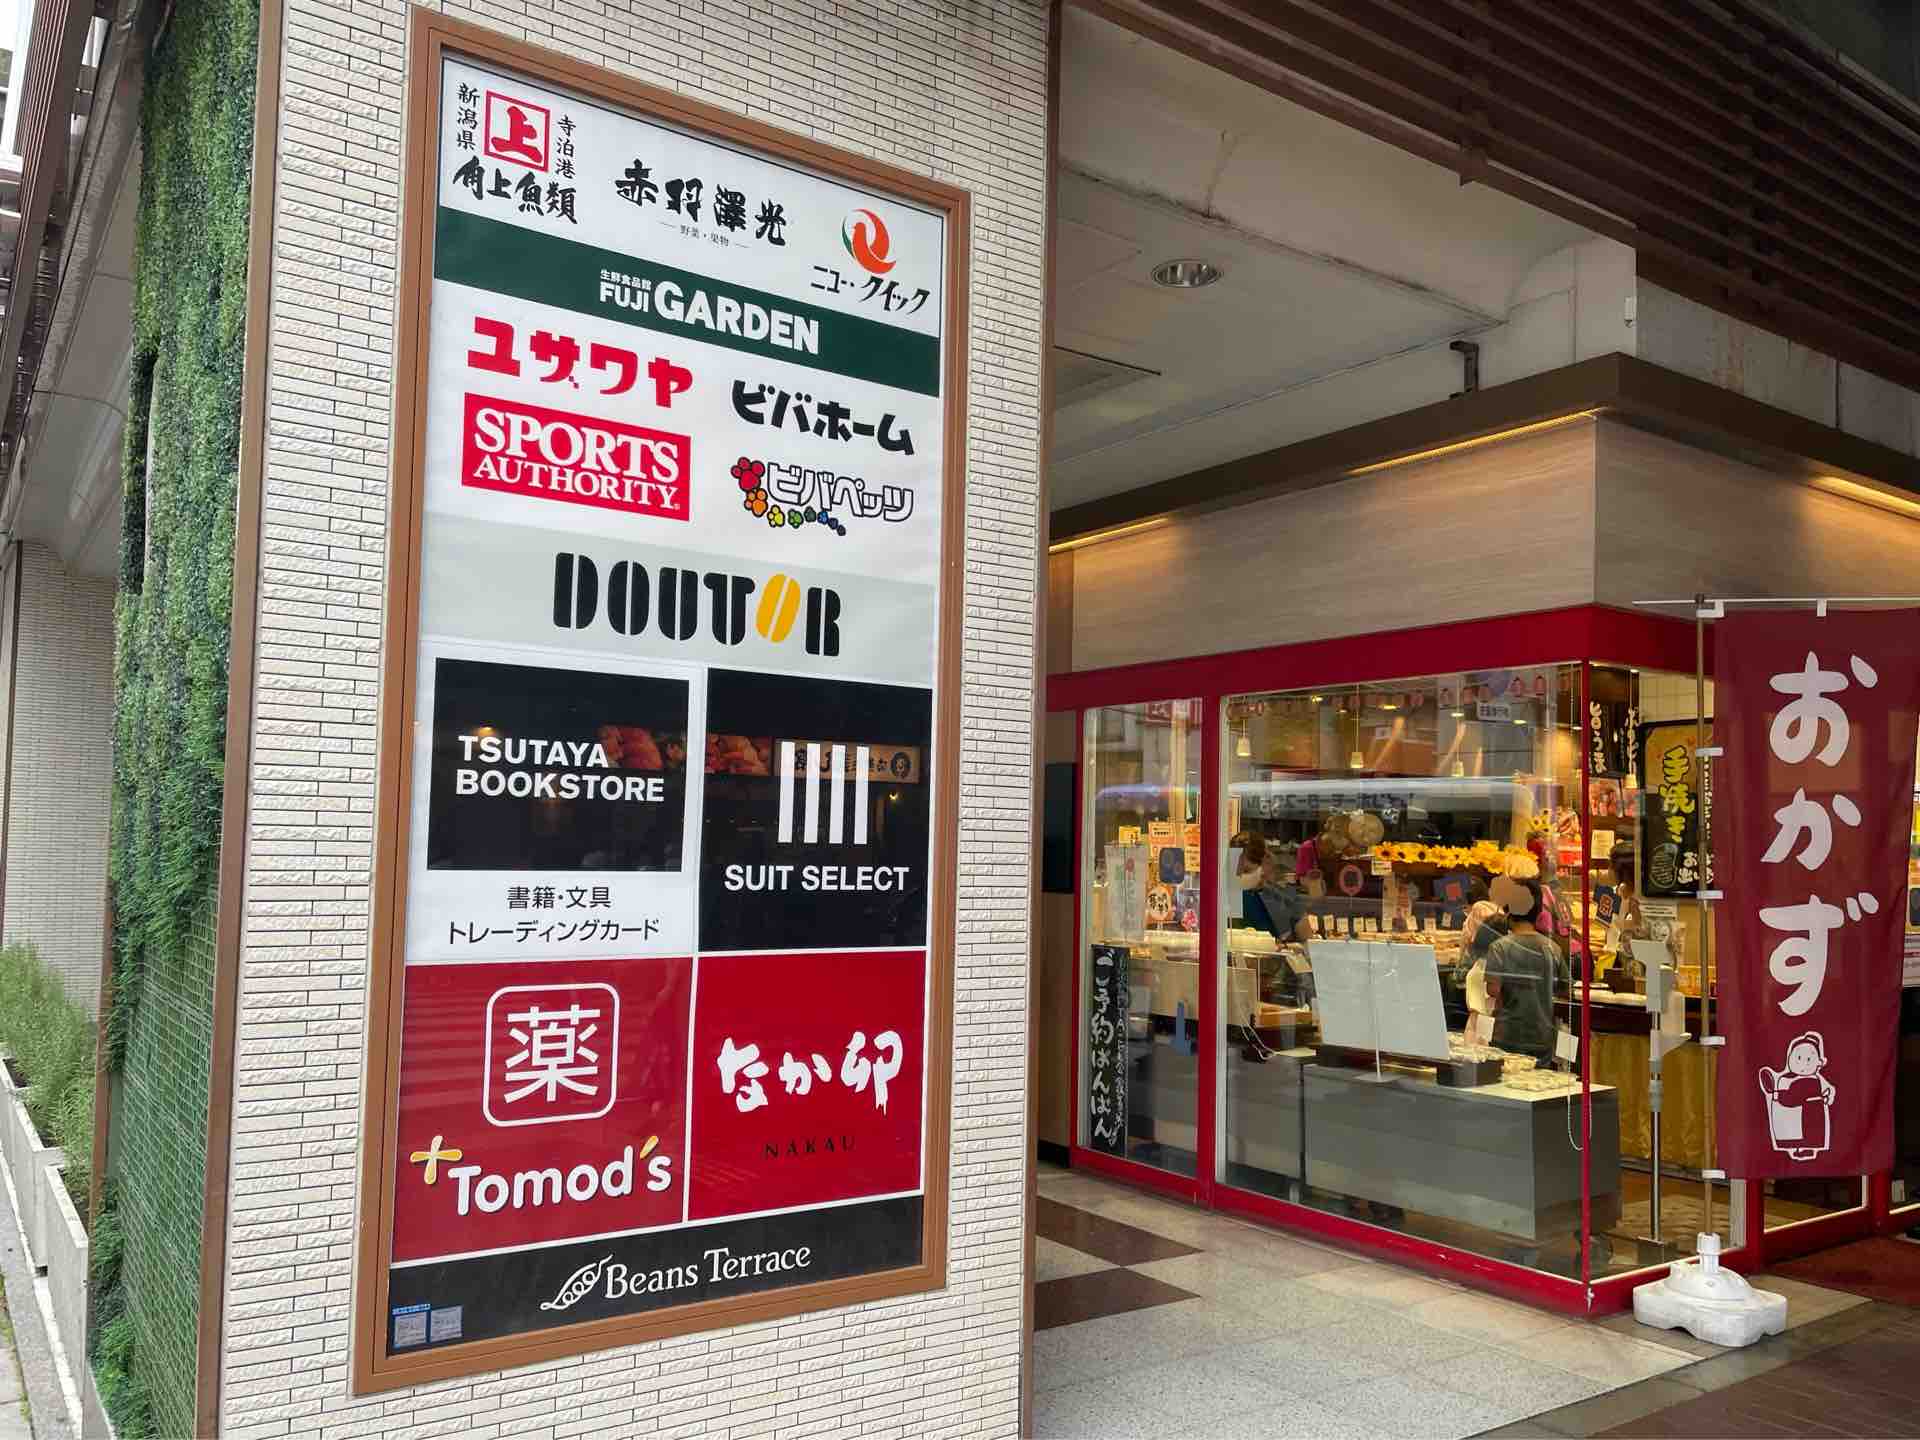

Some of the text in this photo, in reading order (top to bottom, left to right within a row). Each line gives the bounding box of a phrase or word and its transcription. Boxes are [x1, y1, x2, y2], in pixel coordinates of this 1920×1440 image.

[457, 83, 480, 150] 新潟県
[491, 106, 543, 163] 上
[556, 115, 577, 179] 寺泊港
[453, 155, 577, 224] 角上魚類
[615, 158, 786, 246] 赤羽澤光
[600, 281, 819, 354] FUJI GARDEN
[468, 316, 693, 409] ユザワヤ
[474, 407, 680, 485] SPORTS
[731, 379, 915, 456] ビバホーム
[472, 455, 679, 510] AUTHORITY
[766, 462, 914, 523] ビバペッツ
[553, 551, 841, 657] DOUTOR
[456, 769, 665, 802] BOOKSTORE
[458, 735, 609, 769] TSUTAYA
[1759, 649, 1879, 1018] おかず
[506, 886, 612, 910] 書籍・文具
[725, 864, 910, 892] SUIT SELECT
[449, 918, 660, 945] トレーディングカード
[504, 1004, 600, 1104] 薬
[717, 1031, 903, 1117] なか卯
[448, 1135, 673, 1216] Tomod's
[765, 1136, 857, 1160] NAKAU
[604, 1244, 811, 1299] Beans Terrace
